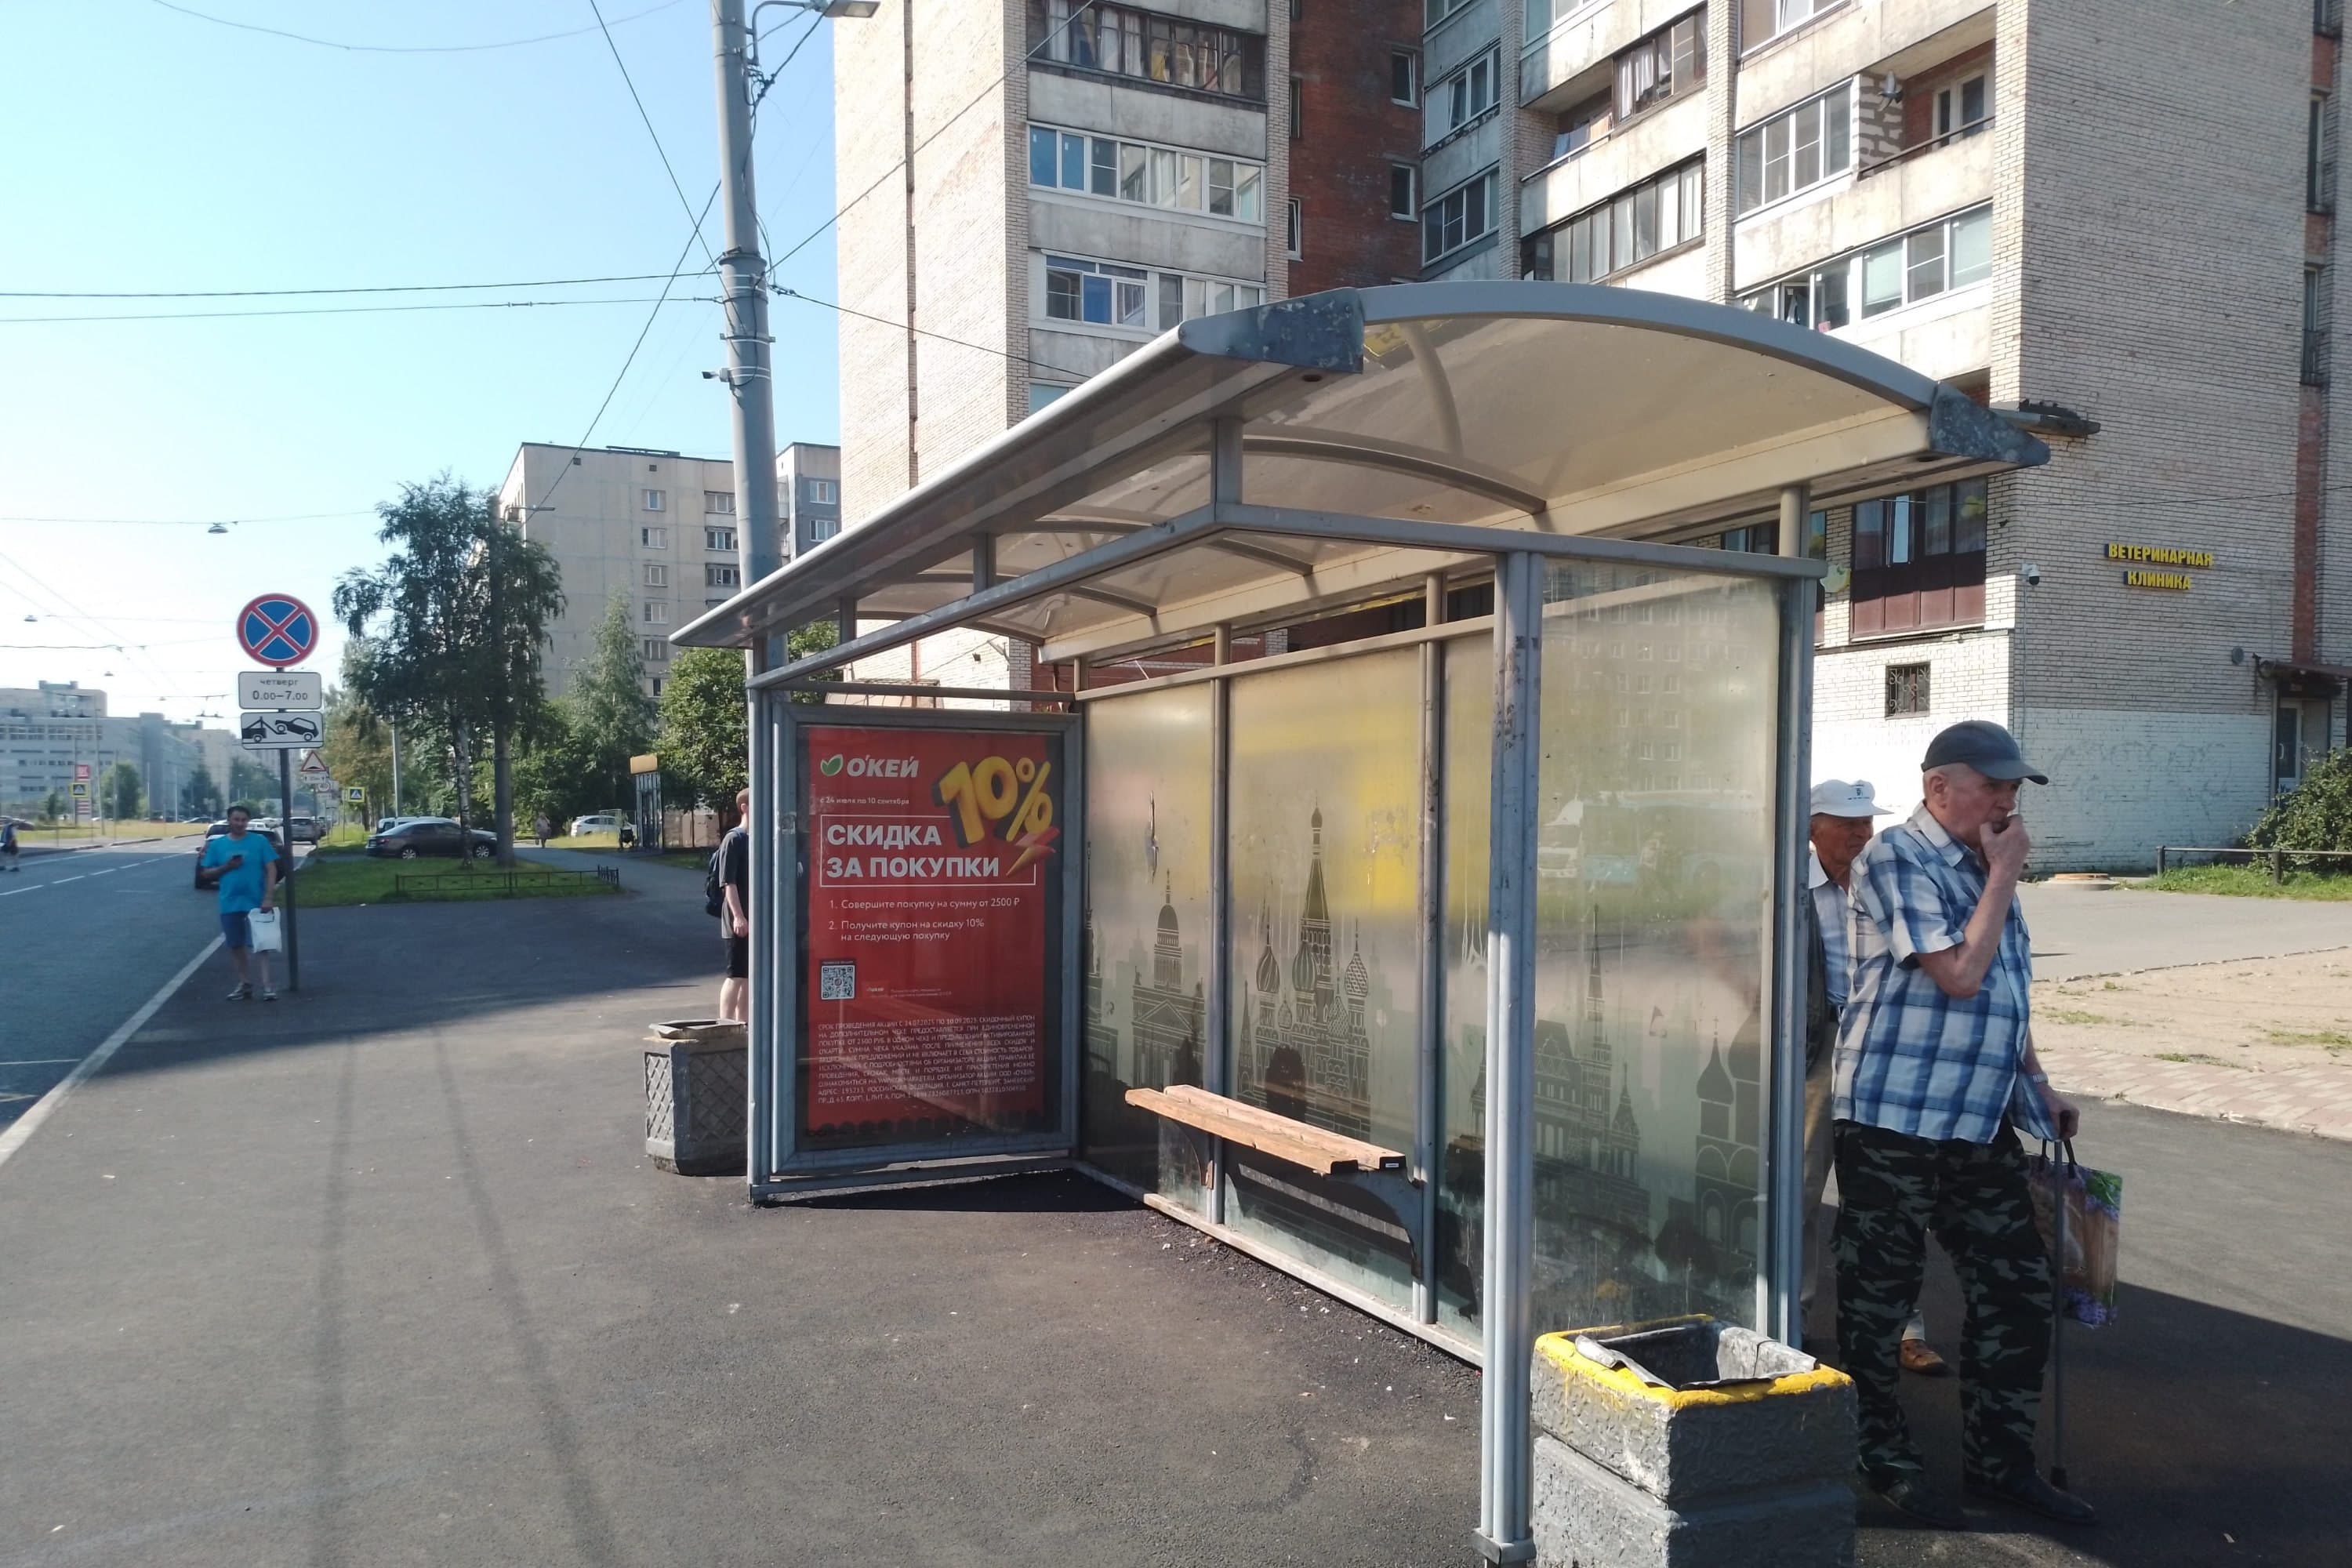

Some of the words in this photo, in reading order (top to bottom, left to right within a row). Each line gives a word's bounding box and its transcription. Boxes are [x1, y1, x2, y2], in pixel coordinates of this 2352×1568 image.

[2107, 543, 2214, 567] ВЕТЕРИНАРНАЯ
[2125, 570, 2191, 590] КЛИНИКА
[260, 679, 299, 688] четверг
[938, 755, 1054, 845] 10%
[826, 824, 942, 850] СКИДКА
[826, 858, 863, 878] ЗА
[869, 857, 1000, 877] ПОКУПКИ
[829, 899, 838, 909] 1.
[841, 899, 895, 910] Совершите
[897, 901, 935, 910] покупку
[949, 901, 978, 909] сумму
[990, 898, 1012, 906] 2500
[828, 920, 837, 930] 2.
[841, 920, 887, 931] Получите
[890, 921, 917, 931] купон
[932, 921, 964, 930] скидку
[965, 918, 985, 927] 10%
[854, 933, 910, 942] следующую
[913, 932, 950, 942] покупку
